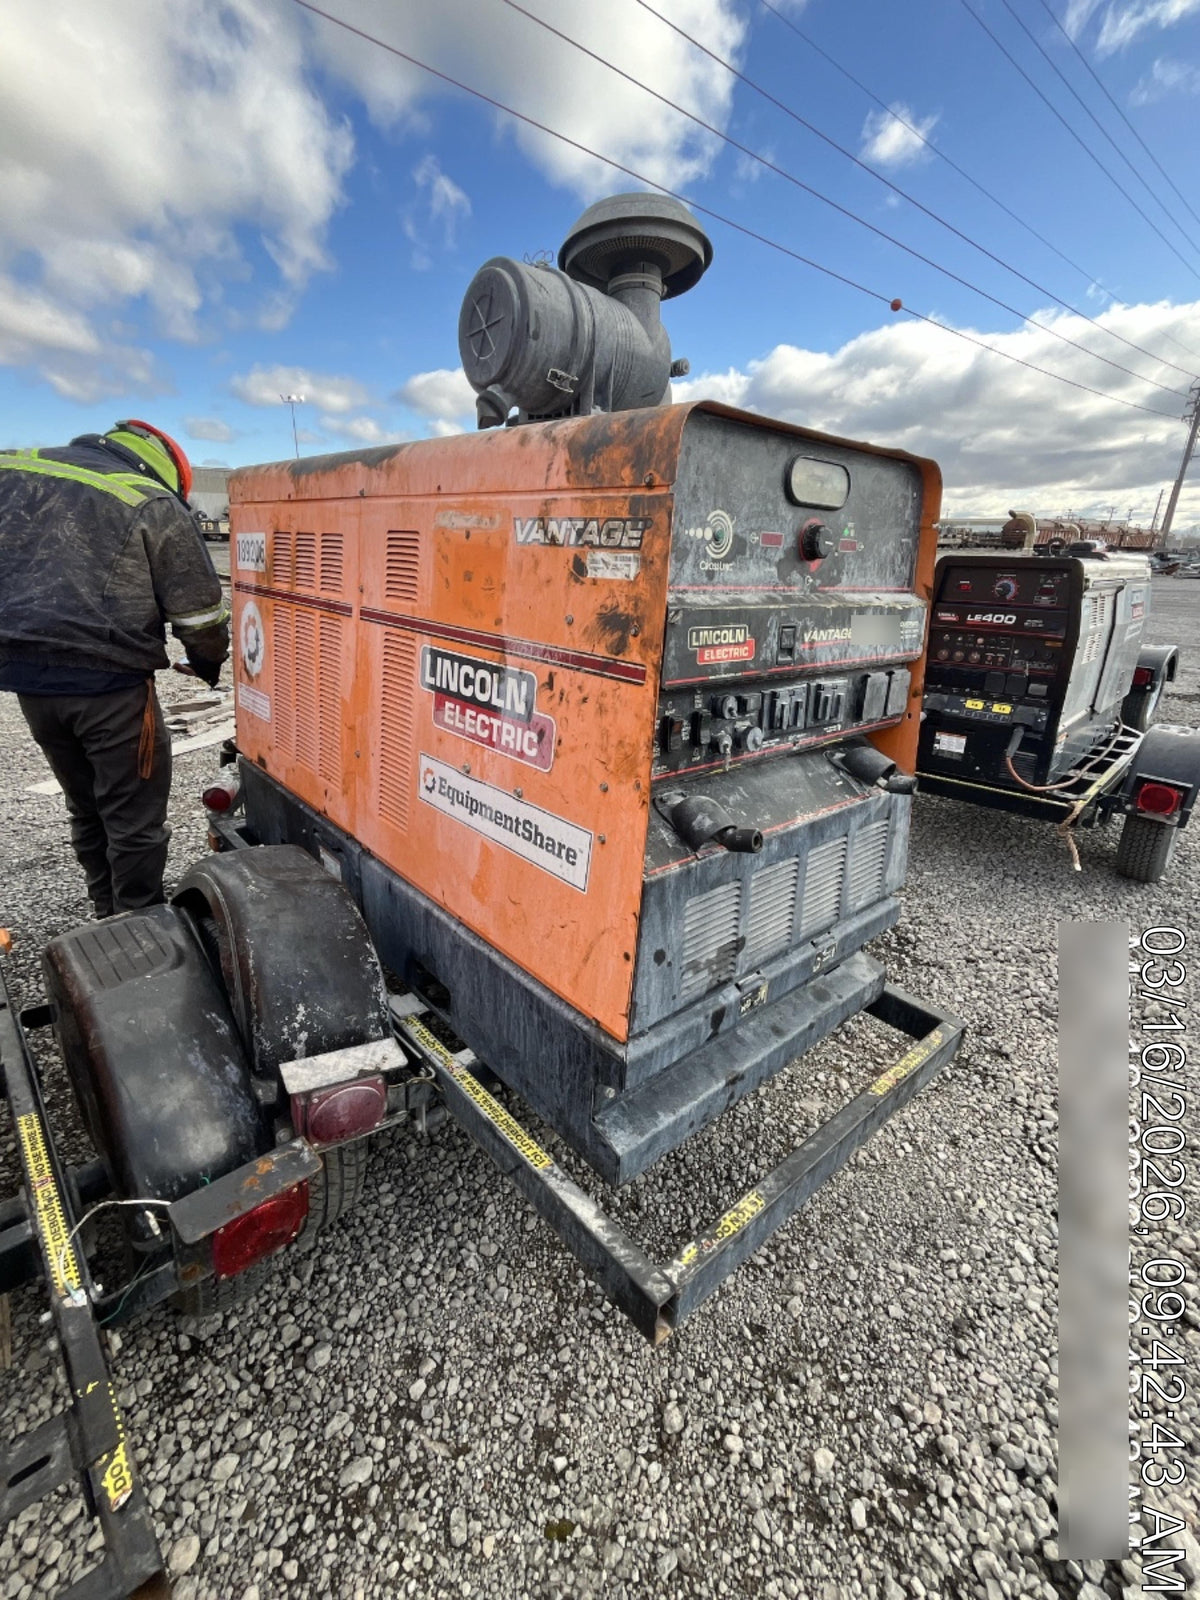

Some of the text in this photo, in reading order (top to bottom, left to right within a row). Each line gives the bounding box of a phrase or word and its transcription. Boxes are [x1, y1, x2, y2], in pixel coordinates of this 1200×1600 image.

[514, 518, 645, 549] VANTAGE
[966, 613, 1017, 625] LE400
[691, 629, 745, 646] LINCOLN
[703, 646, 749, 661] ELECTRIC
[424, 654, 528, 715] LINCOLN
[443, 701, 539, 757] ELECTRIC
[438, 776, 578, 866] EquipmentShare
[26, 1130, 39, 1152] PARE
[500, 1118, 535, 1152] DEBOUT
[531, 1150, 546, 1165] ICI
[31, 1150, 43, 1164] SE
[34, 1163, 46, 1178] NO
[715, 1224, 731, 1239] DO
[110, 1462, 127, 1493] DO
